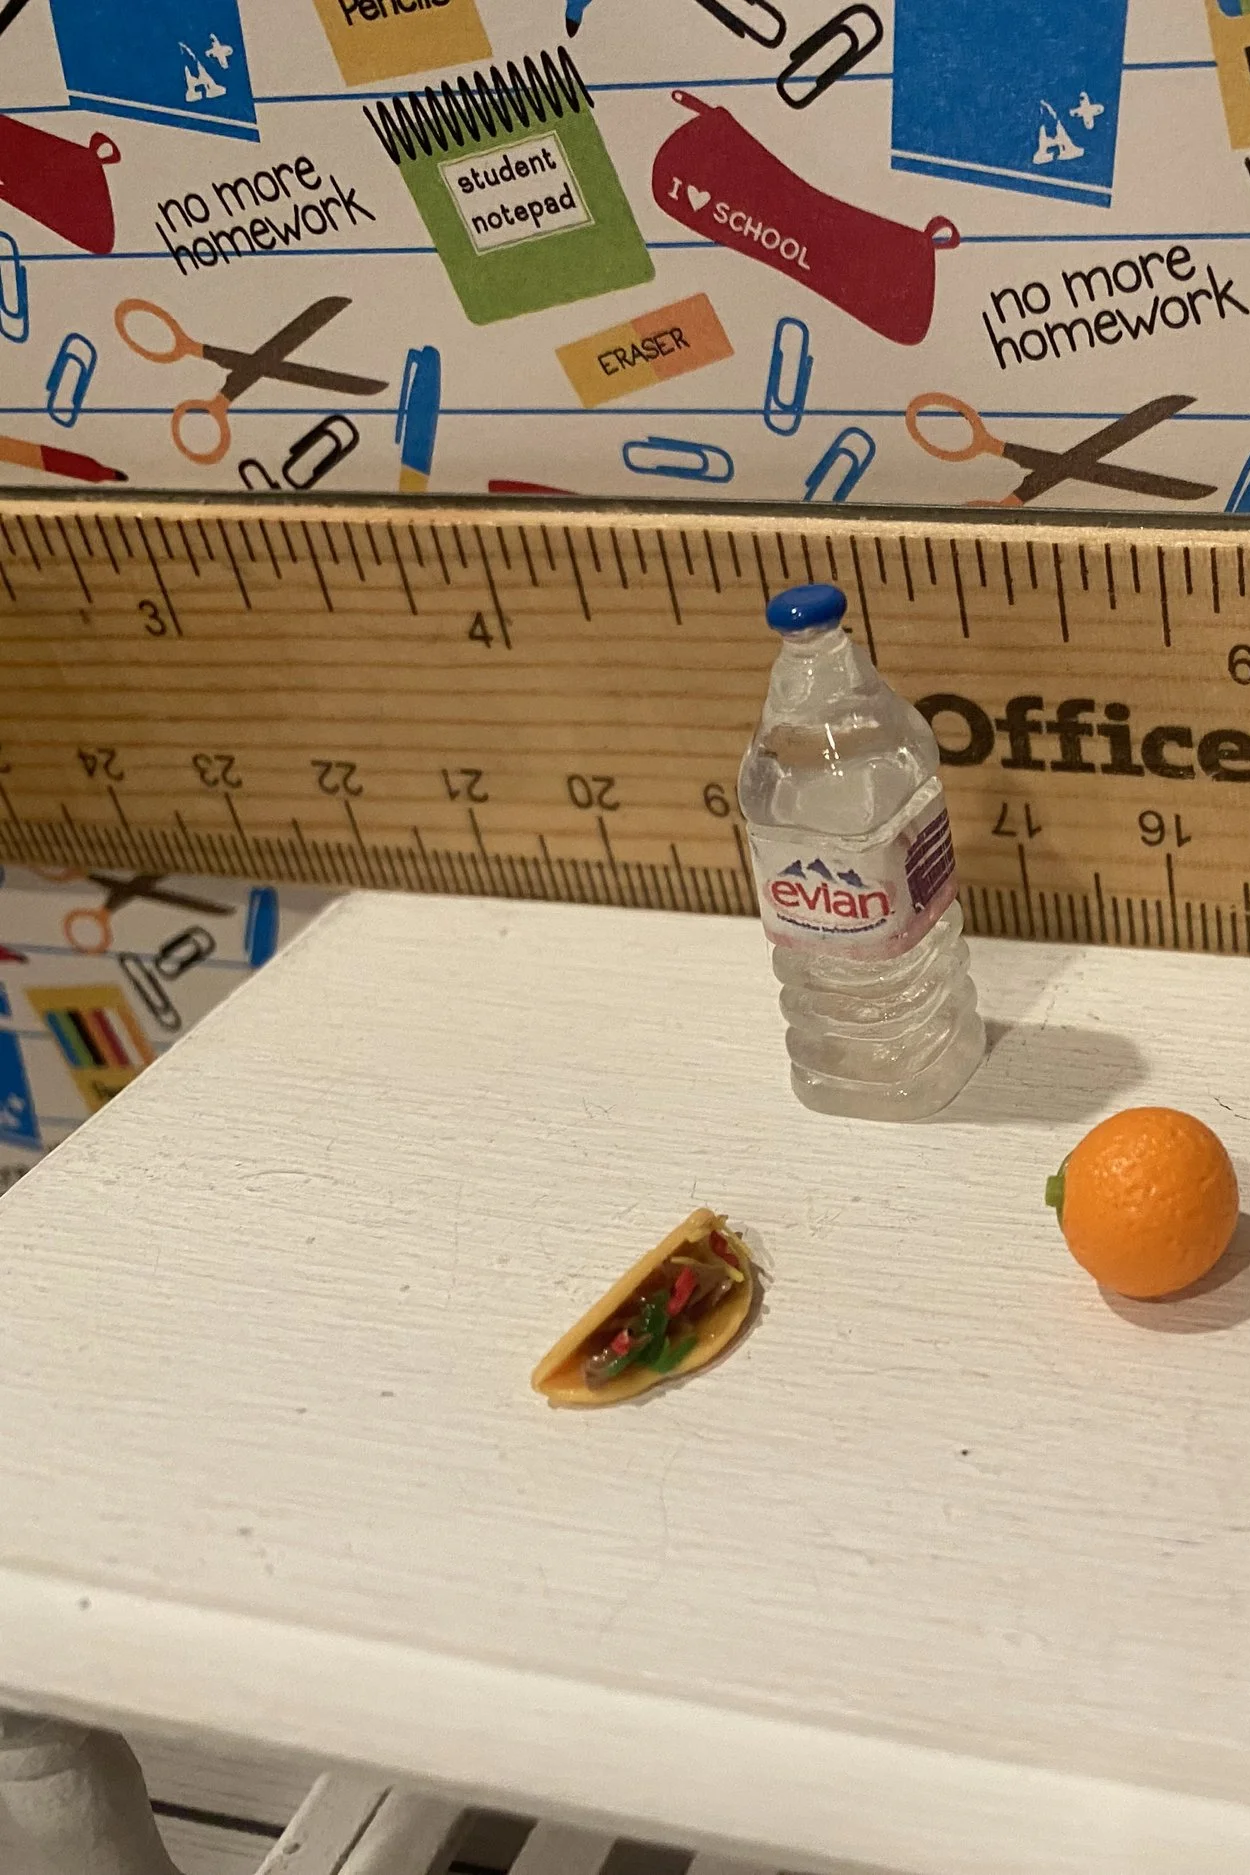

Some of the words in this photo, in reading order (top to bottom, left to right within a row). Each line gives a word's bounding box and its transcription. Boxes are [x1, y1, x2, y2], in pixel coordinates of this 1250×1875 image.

[338, 0, 450, 26] Penc
[458, 147, 557, 194] student
[155, 192, 211, 233] no
[211, 154, 322, 215] more
[470, 182, 578, 236] notepad
[155, 172, 376, 277] homework
[666, 176, 682, 200] I
[713, 200, 812, 273] SCHOOL
[988, 278, 1053, 326] no
[1061, 244, 1196, 297] more
[982, 264, 1250, 370] homework
[598, 326, 690, 376] ERASER
[137, 600, 166, 637] 3
[467, 611, 493, 649] 4
[77, 746, 125, 782] 24
[191, 752, 243, 788] 23
[310, 758, 364, 797] 22
[441, 767, 489, 802] 21
[566, 774, 621, 811] 20
[992, 802, 1043, 840] 17
[1137, 808, 1193, 849] 16
[770, 880, 890, 919] evian
